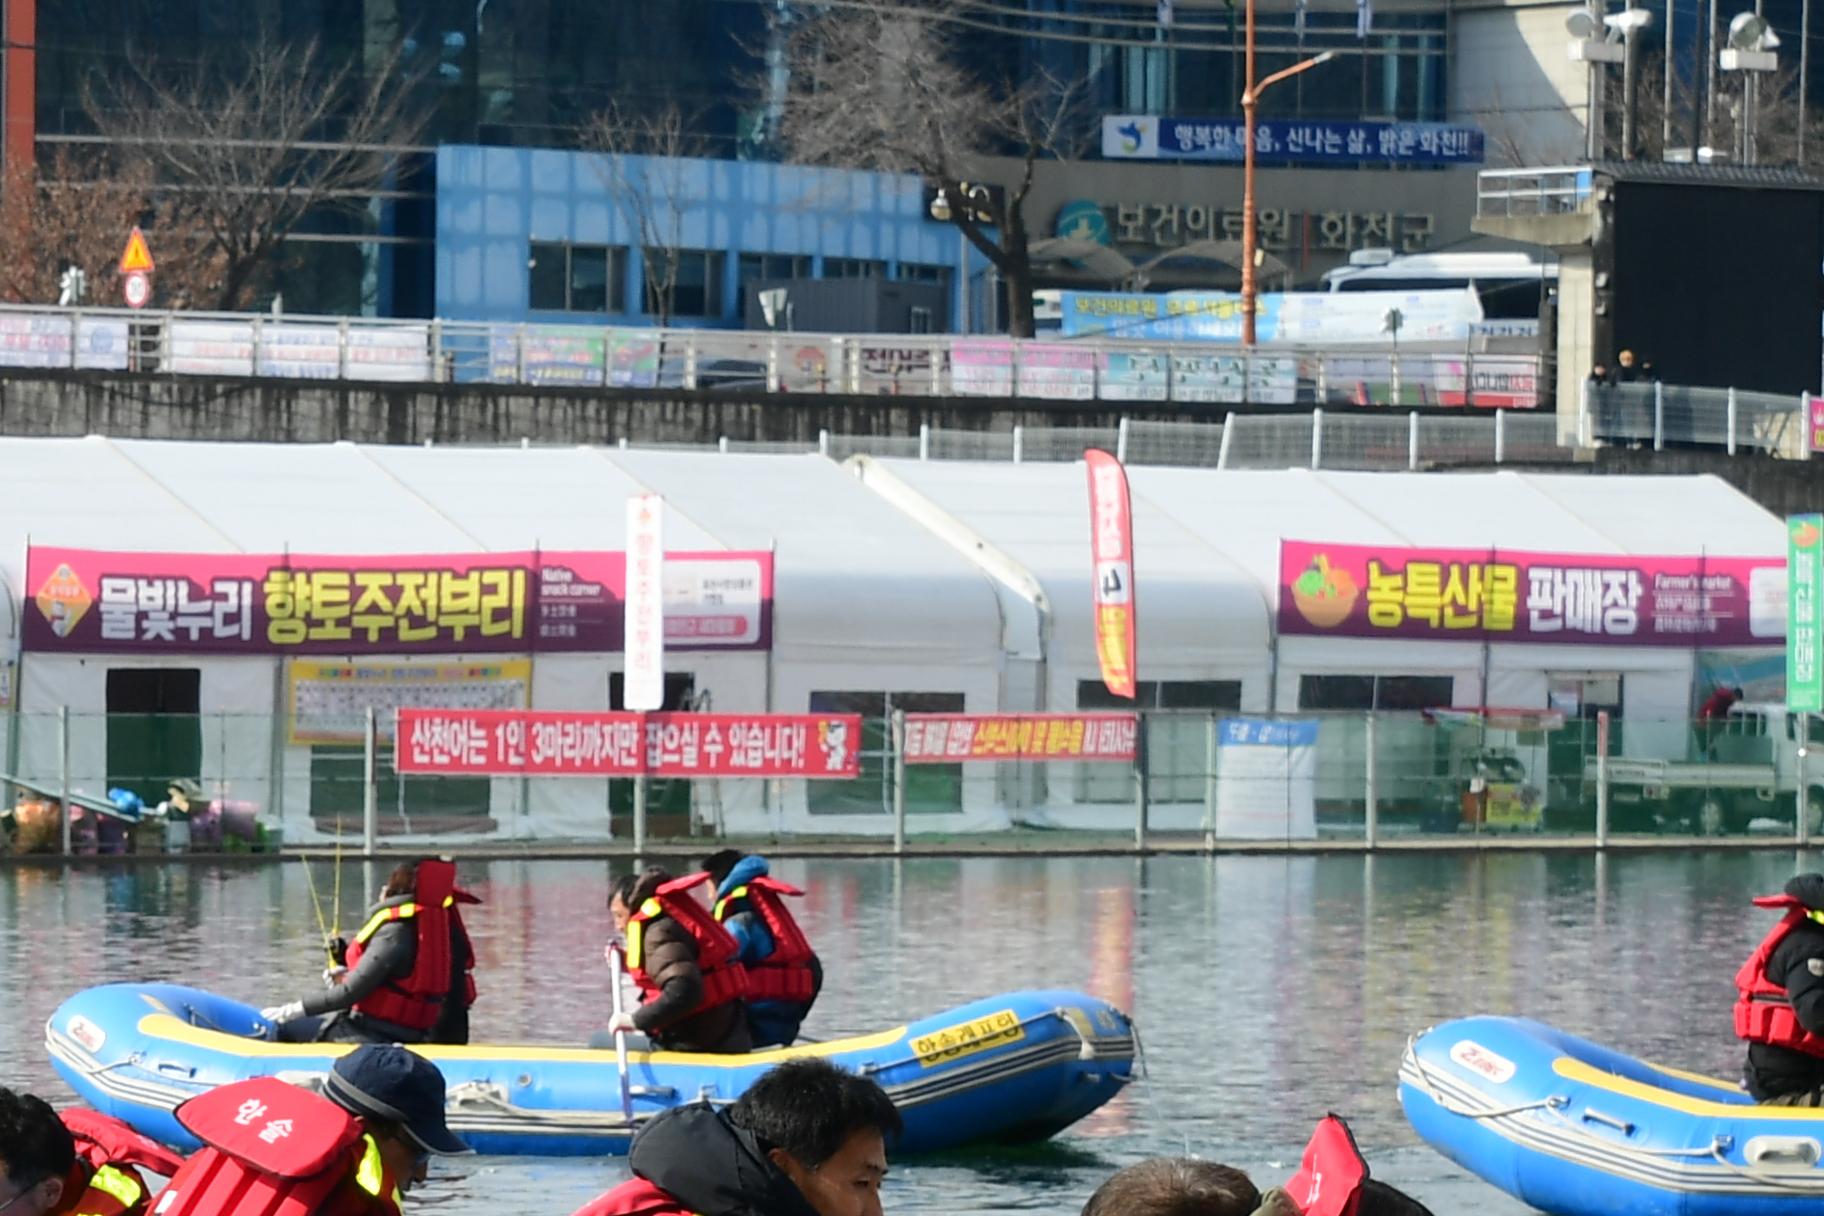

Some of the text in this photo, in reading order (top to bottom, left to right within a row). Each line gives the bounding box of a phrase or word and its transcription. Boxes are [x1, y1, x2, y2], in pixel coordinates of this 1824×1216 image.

[1174, 125, 1232, 152] 행복한
[1285, 127, 1343, 153] 신나는
[1347, 128, 1373, 155] 삶,
[1379, 129, 1416, 157] 밝은
[1320, 211, 1436, 252] 화천군
[99, 576, 253, 642] 물빛누리
[263, 567, 525, 645] 향토주전부리
[1366, 560, 1518, 632] 농특산물
[1526, 567, 1644, 635] 판매장
[410, 719, 808, 769] 산천어는 1인 3마리까지만 잡으실 수 있습니다!
